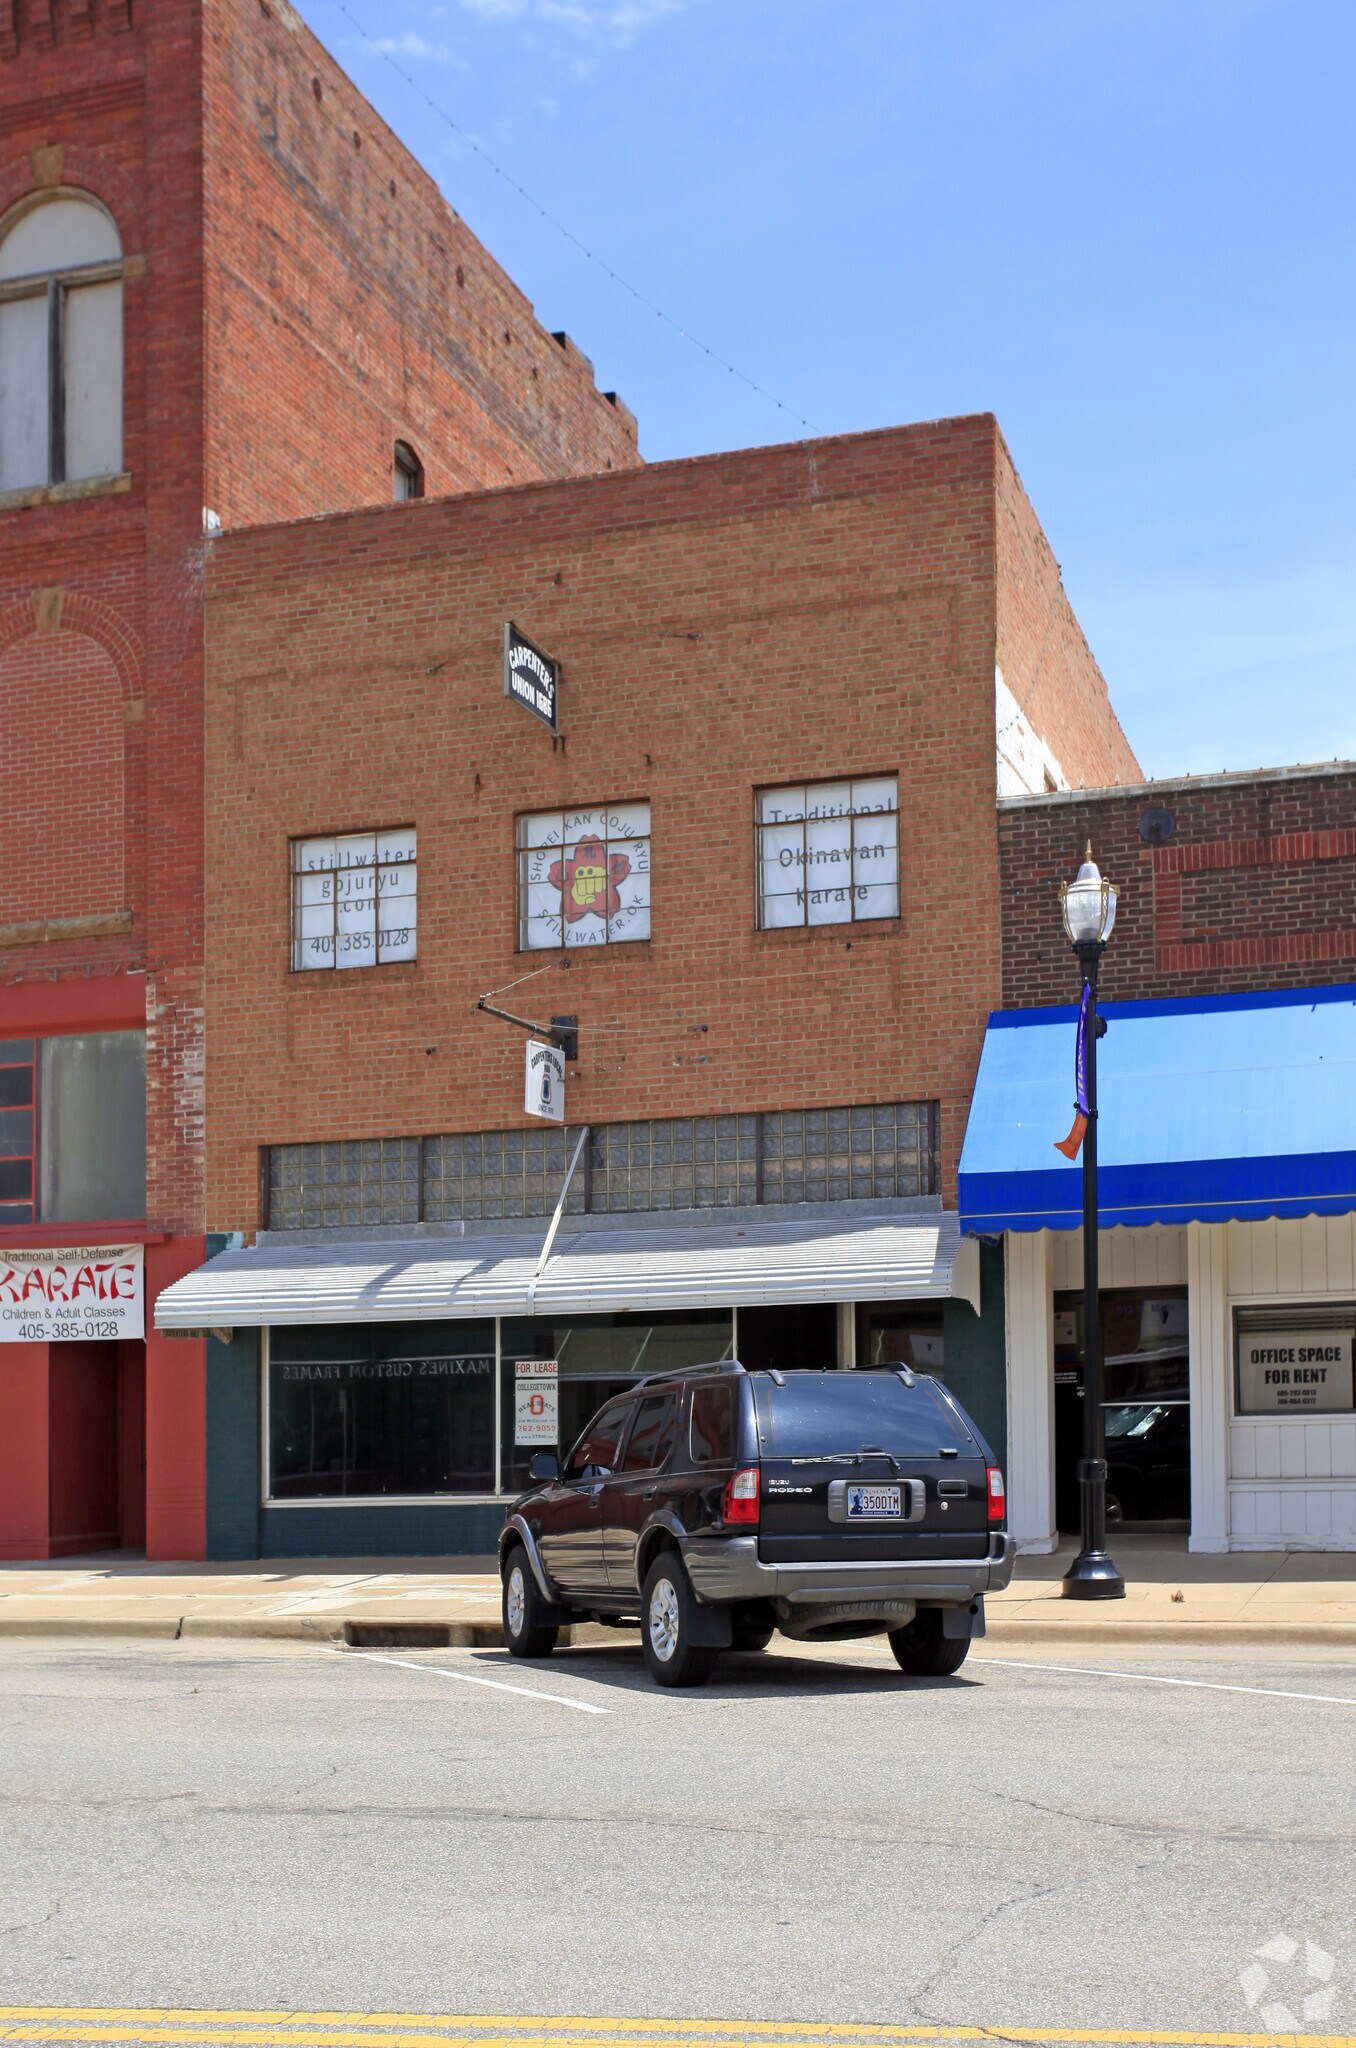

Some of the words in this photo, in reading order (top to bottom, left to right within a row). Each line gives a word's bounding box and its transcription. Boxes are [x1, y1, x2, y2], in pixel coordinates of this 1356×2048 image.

[511, 670, 535, 705] UNION
[770, 798, 892, 824] Traditional
[563, 813, 592, 831] KAN
[633, 841, 648, 870] RYU
[308, 848, 415, 872] stillwater
[779, 844, 886, 867] Okinawan
[321, 873, 399, 898] gojuryu
[3, 1250, 55, 1263] Traditional
[57, 1248, 125, 1261] Self-Defense
[0, 1262, 136, 1303] KARATE
[2, 1308, 42, 1320] Children
[44, 1308, 52, 1319] &
[55, 1307, 81, 1319] Adult
[83, 1306, 126, 1318] Classes
[18, 1321, 119, 1339] 405-385-0128
[1250, 1348, 1295, 1364] OFFICE
[1298, 1347, 1342, 1363] SPACE
[516, 1363, 531, 1374] FOR
[534, 1363, 558, 1373] LEASE
[1264, 1369, 1290, 1385] FOR
[1293, 1368, 1328, 1383] RENT
[517, 1383, 556, 1391] COLLEGETOWN
